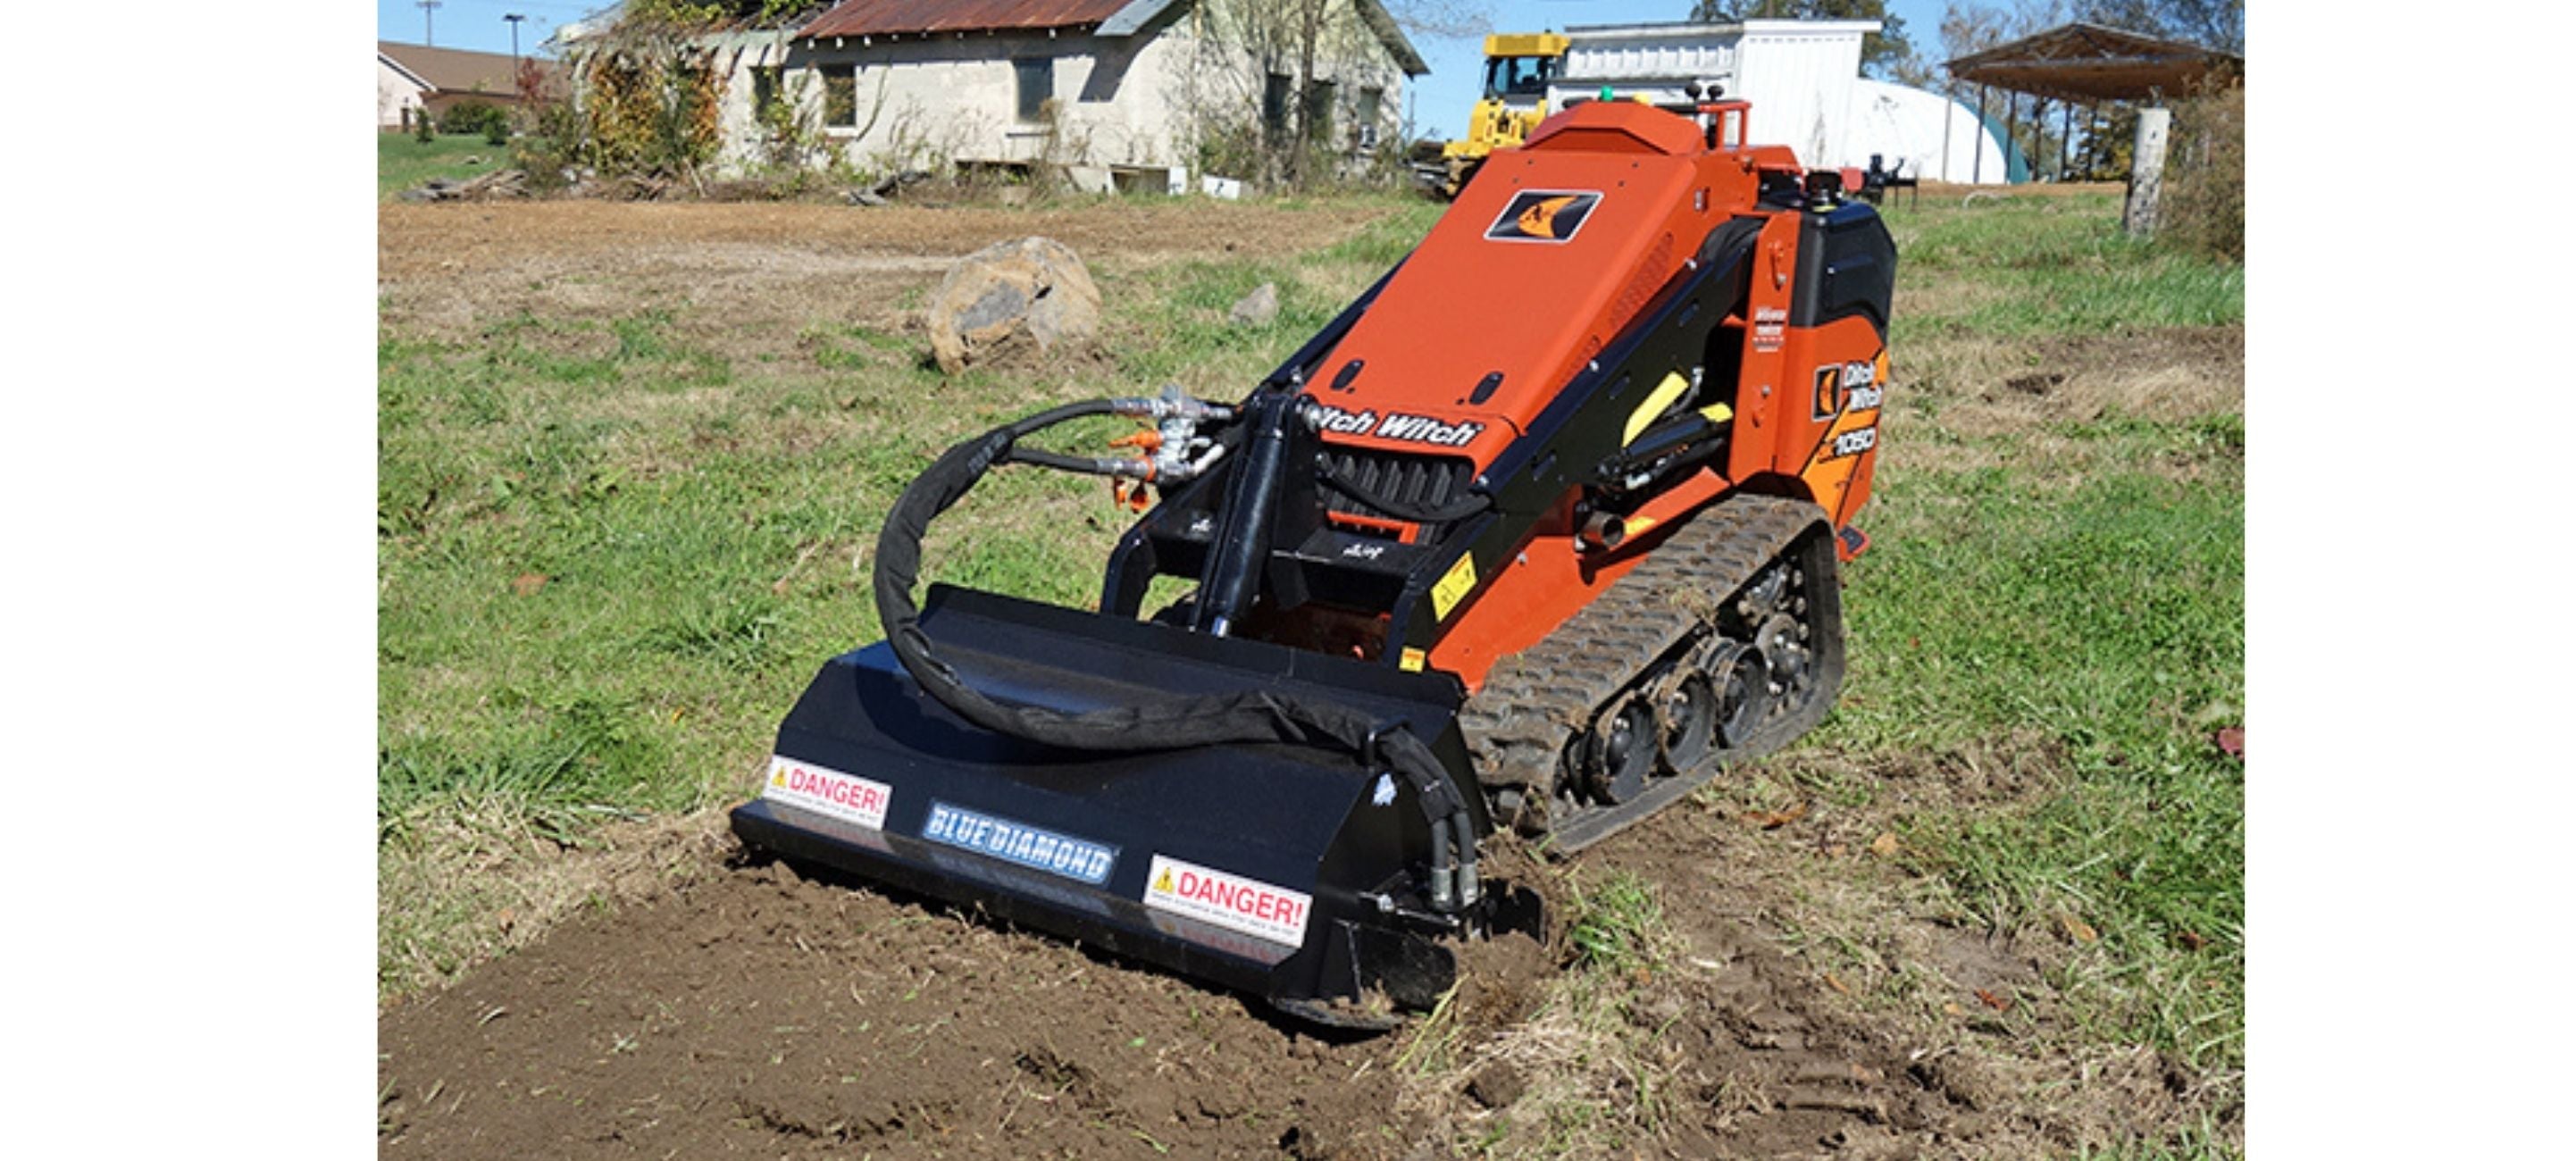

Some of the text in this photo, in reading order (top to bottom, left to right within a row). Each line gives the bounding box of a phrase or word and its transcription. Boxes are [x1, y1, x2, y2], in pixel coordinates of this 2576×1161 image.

[1850, 385, 1884, 411] Witch
[1376, 413, 1478, 447] Witch
[790, 767, 885, 814] DANGER!
[929, 806, 1113, 879] BLUE DIAMOND
[1177, 871, 1303, 927] DANGER!
